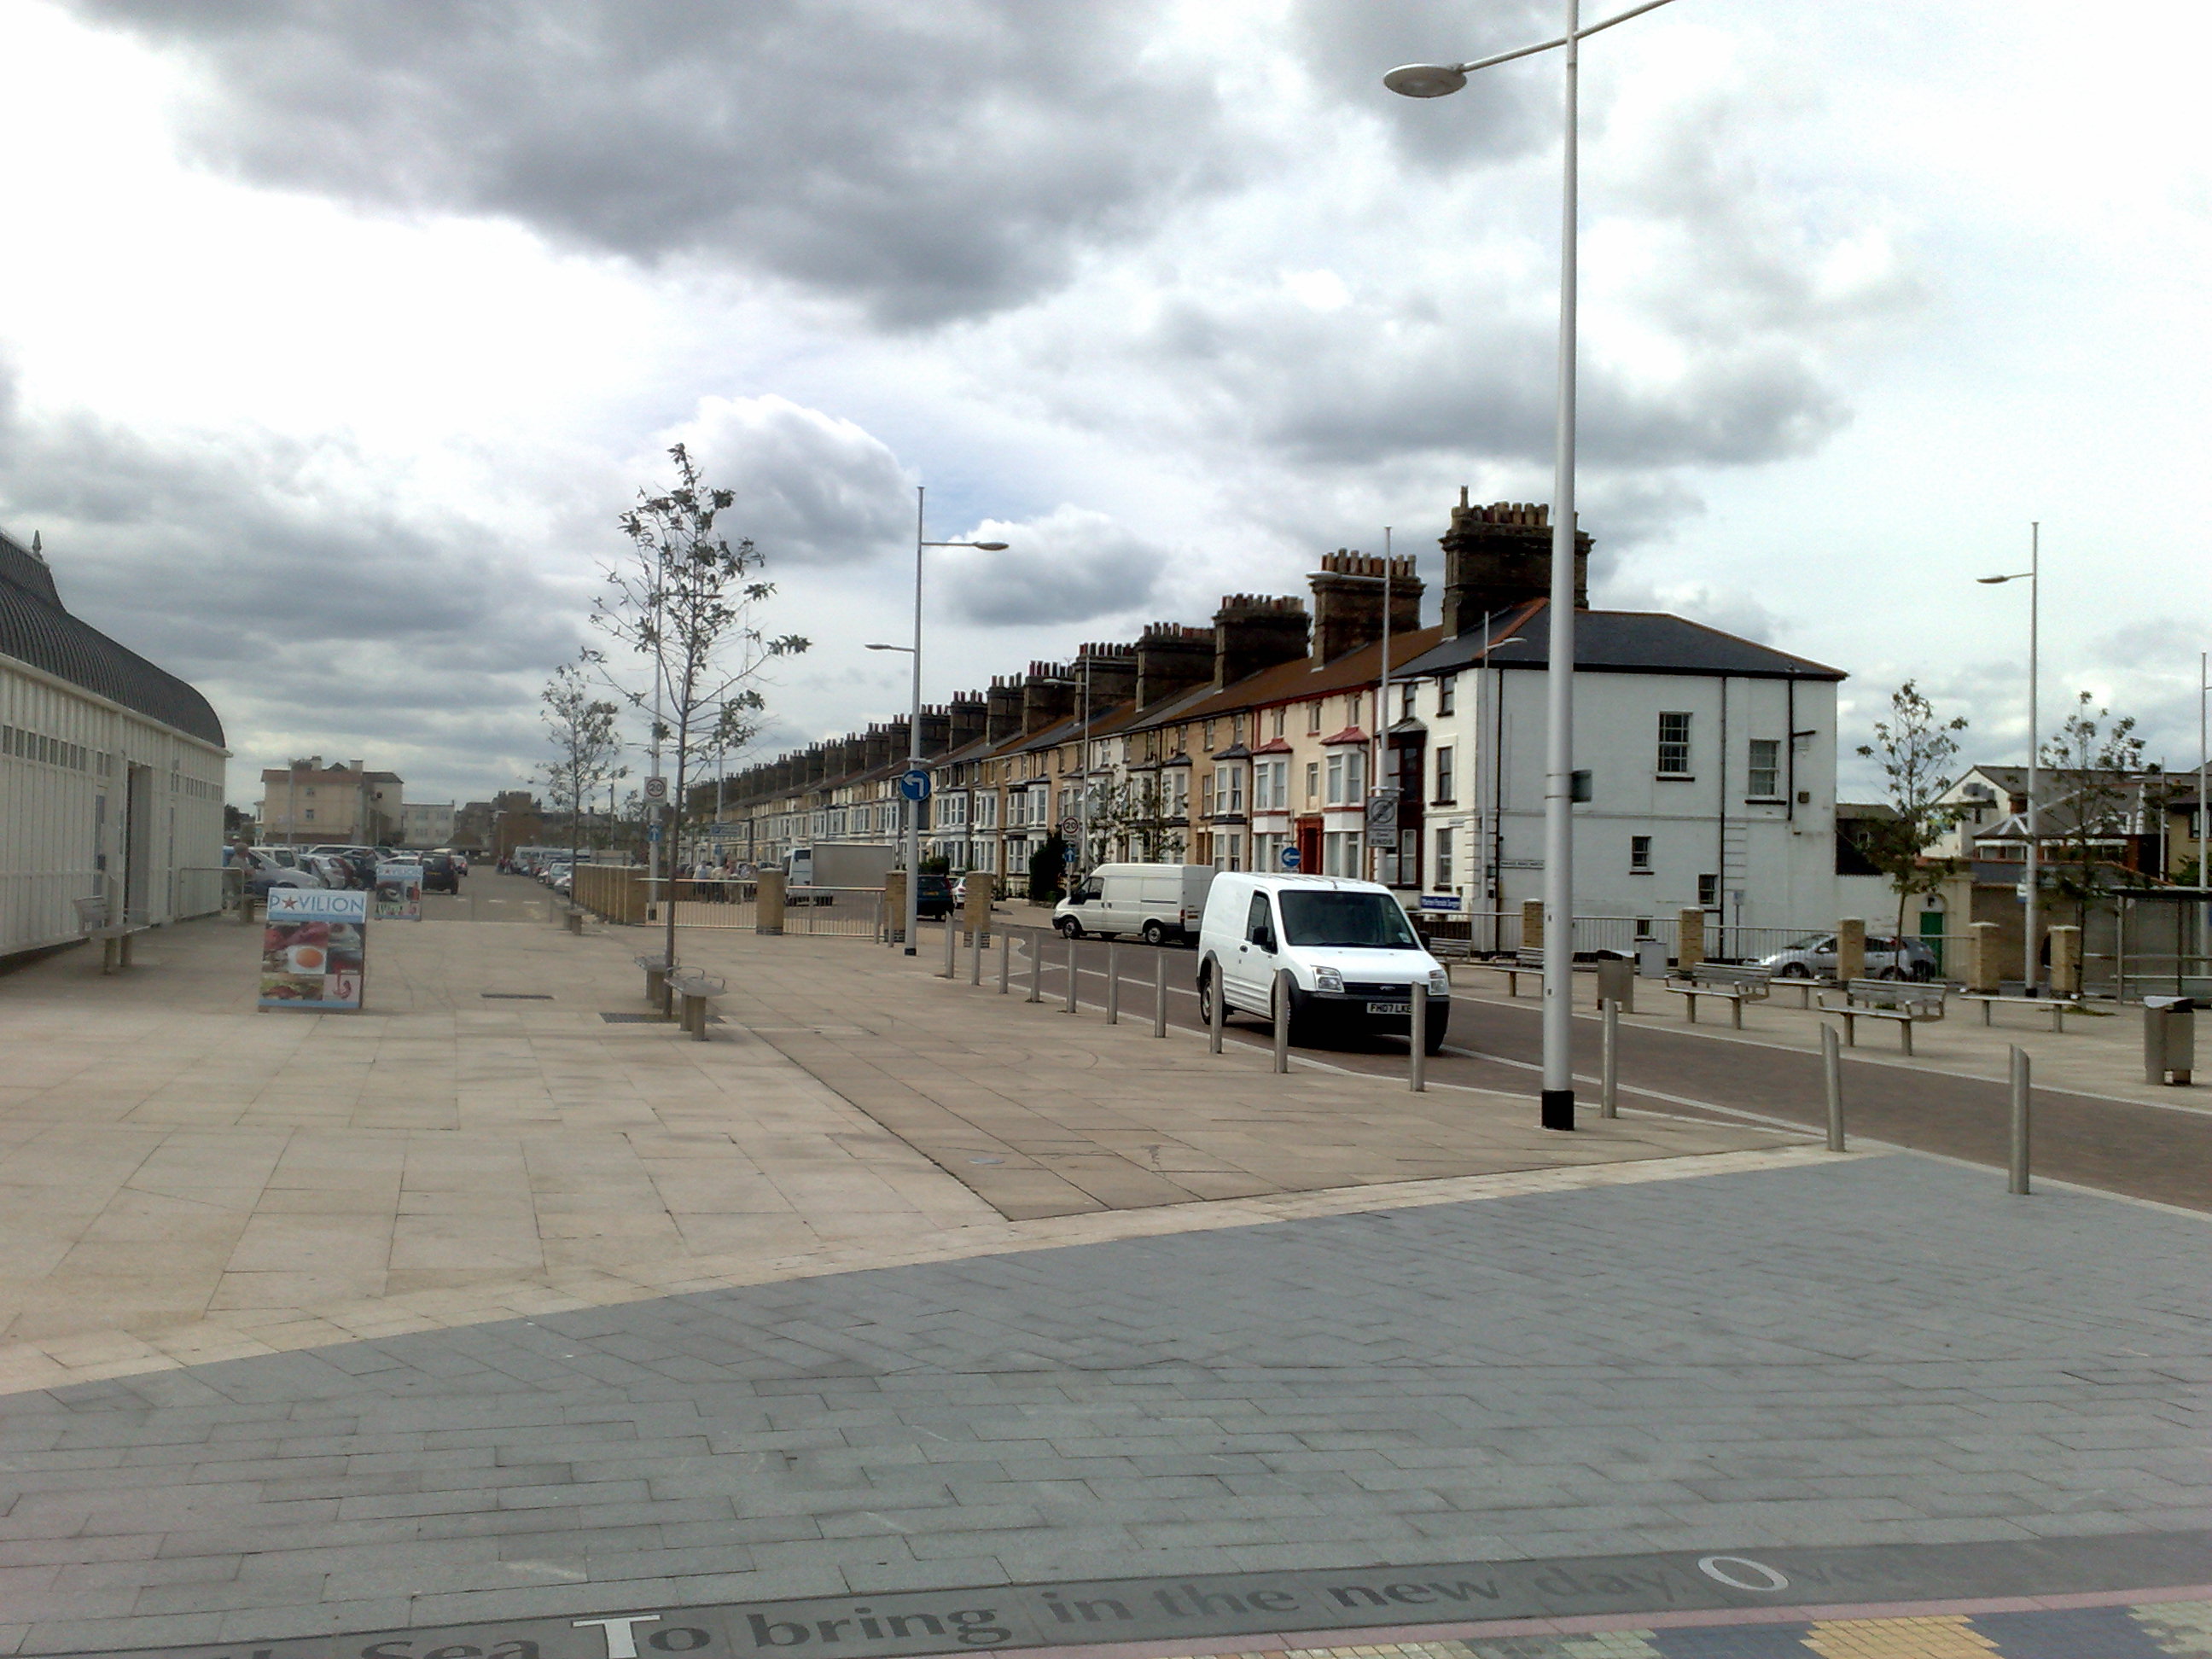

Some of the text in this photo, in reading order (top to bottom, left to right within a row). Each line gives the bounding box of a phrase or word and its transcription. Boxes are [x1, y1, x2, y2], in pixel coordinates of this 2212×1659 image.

[649, 783, 662, 792] 20
[570, 1614, 711, 1659] To
[746, 1607, 1013, 1645] bring
[1041, 1591, 1133, 1625] in
[1152, 1585, 1302, 1618] the
[1325, 1576, 1502, 1608] new
